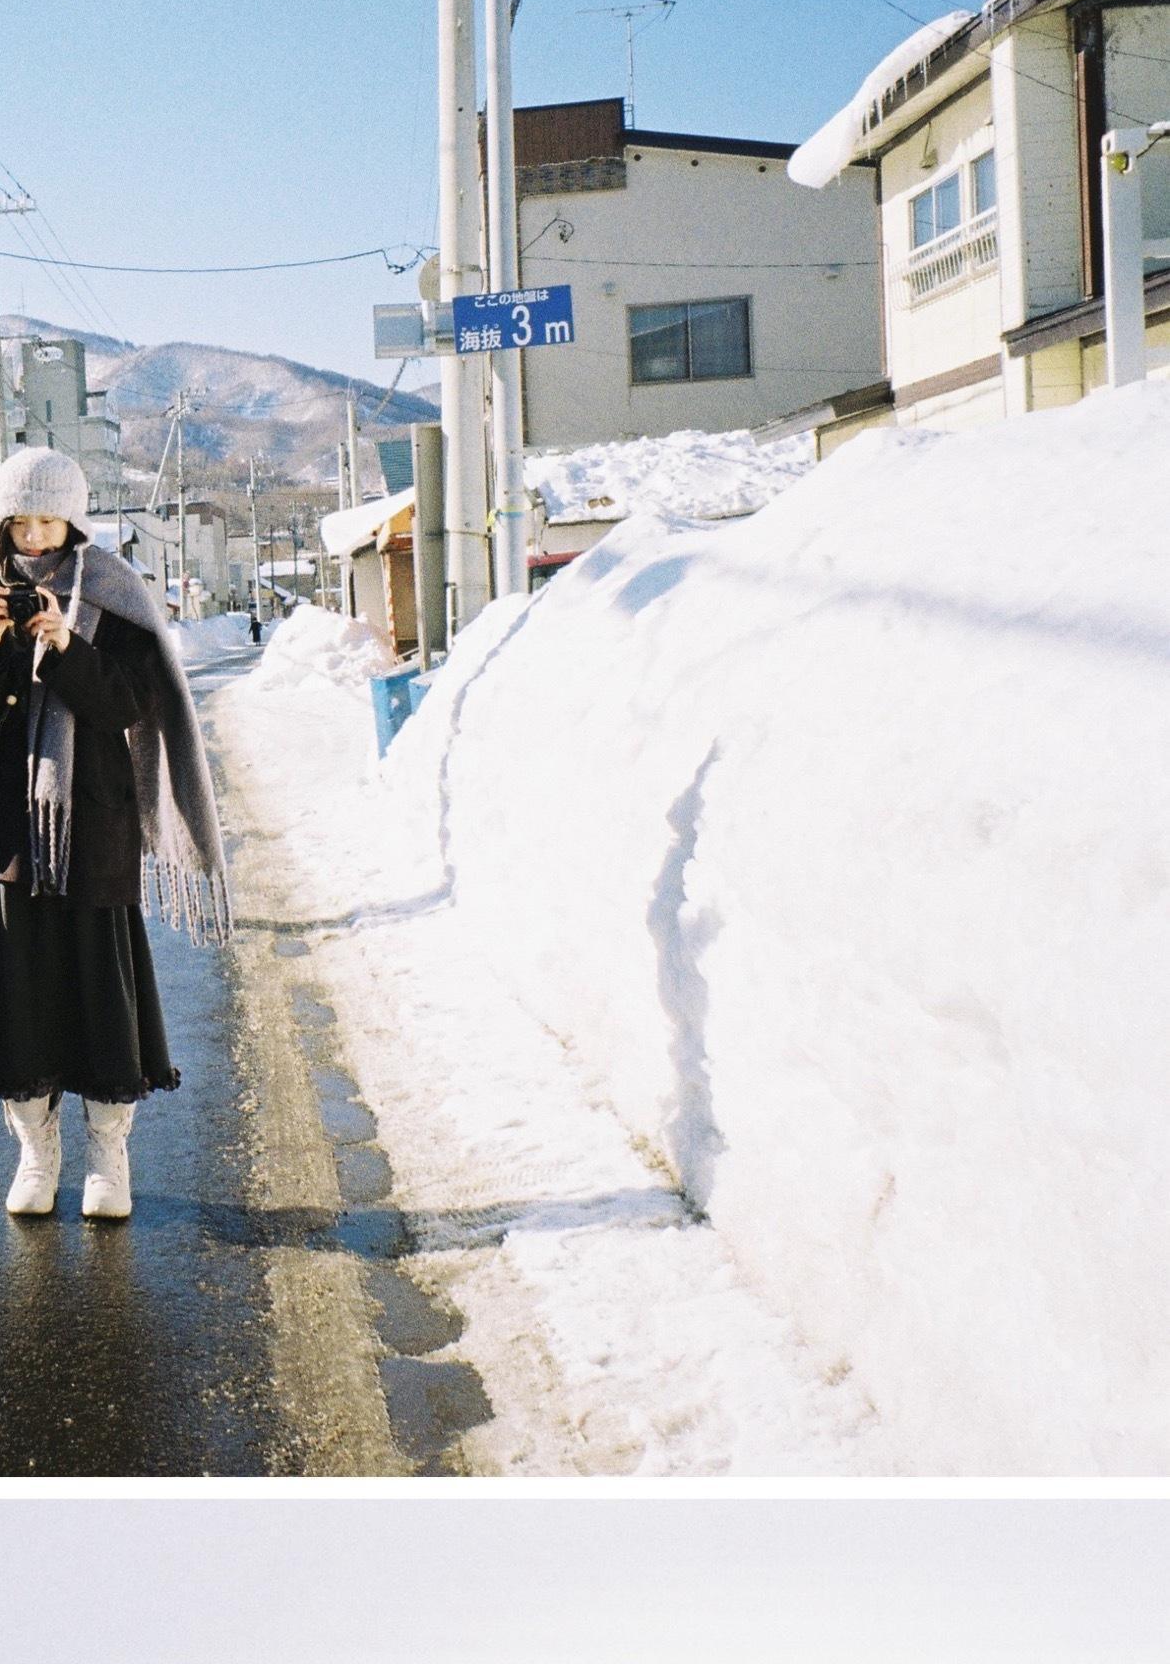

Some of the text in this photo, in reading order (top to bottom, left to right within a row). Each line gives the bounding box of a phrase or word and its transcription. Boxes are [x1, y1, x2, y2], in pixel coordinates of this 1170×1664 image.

[474, 289, 549, 308] ここの地盤は
[460, 305, 570, 352] 海抜 3 m
